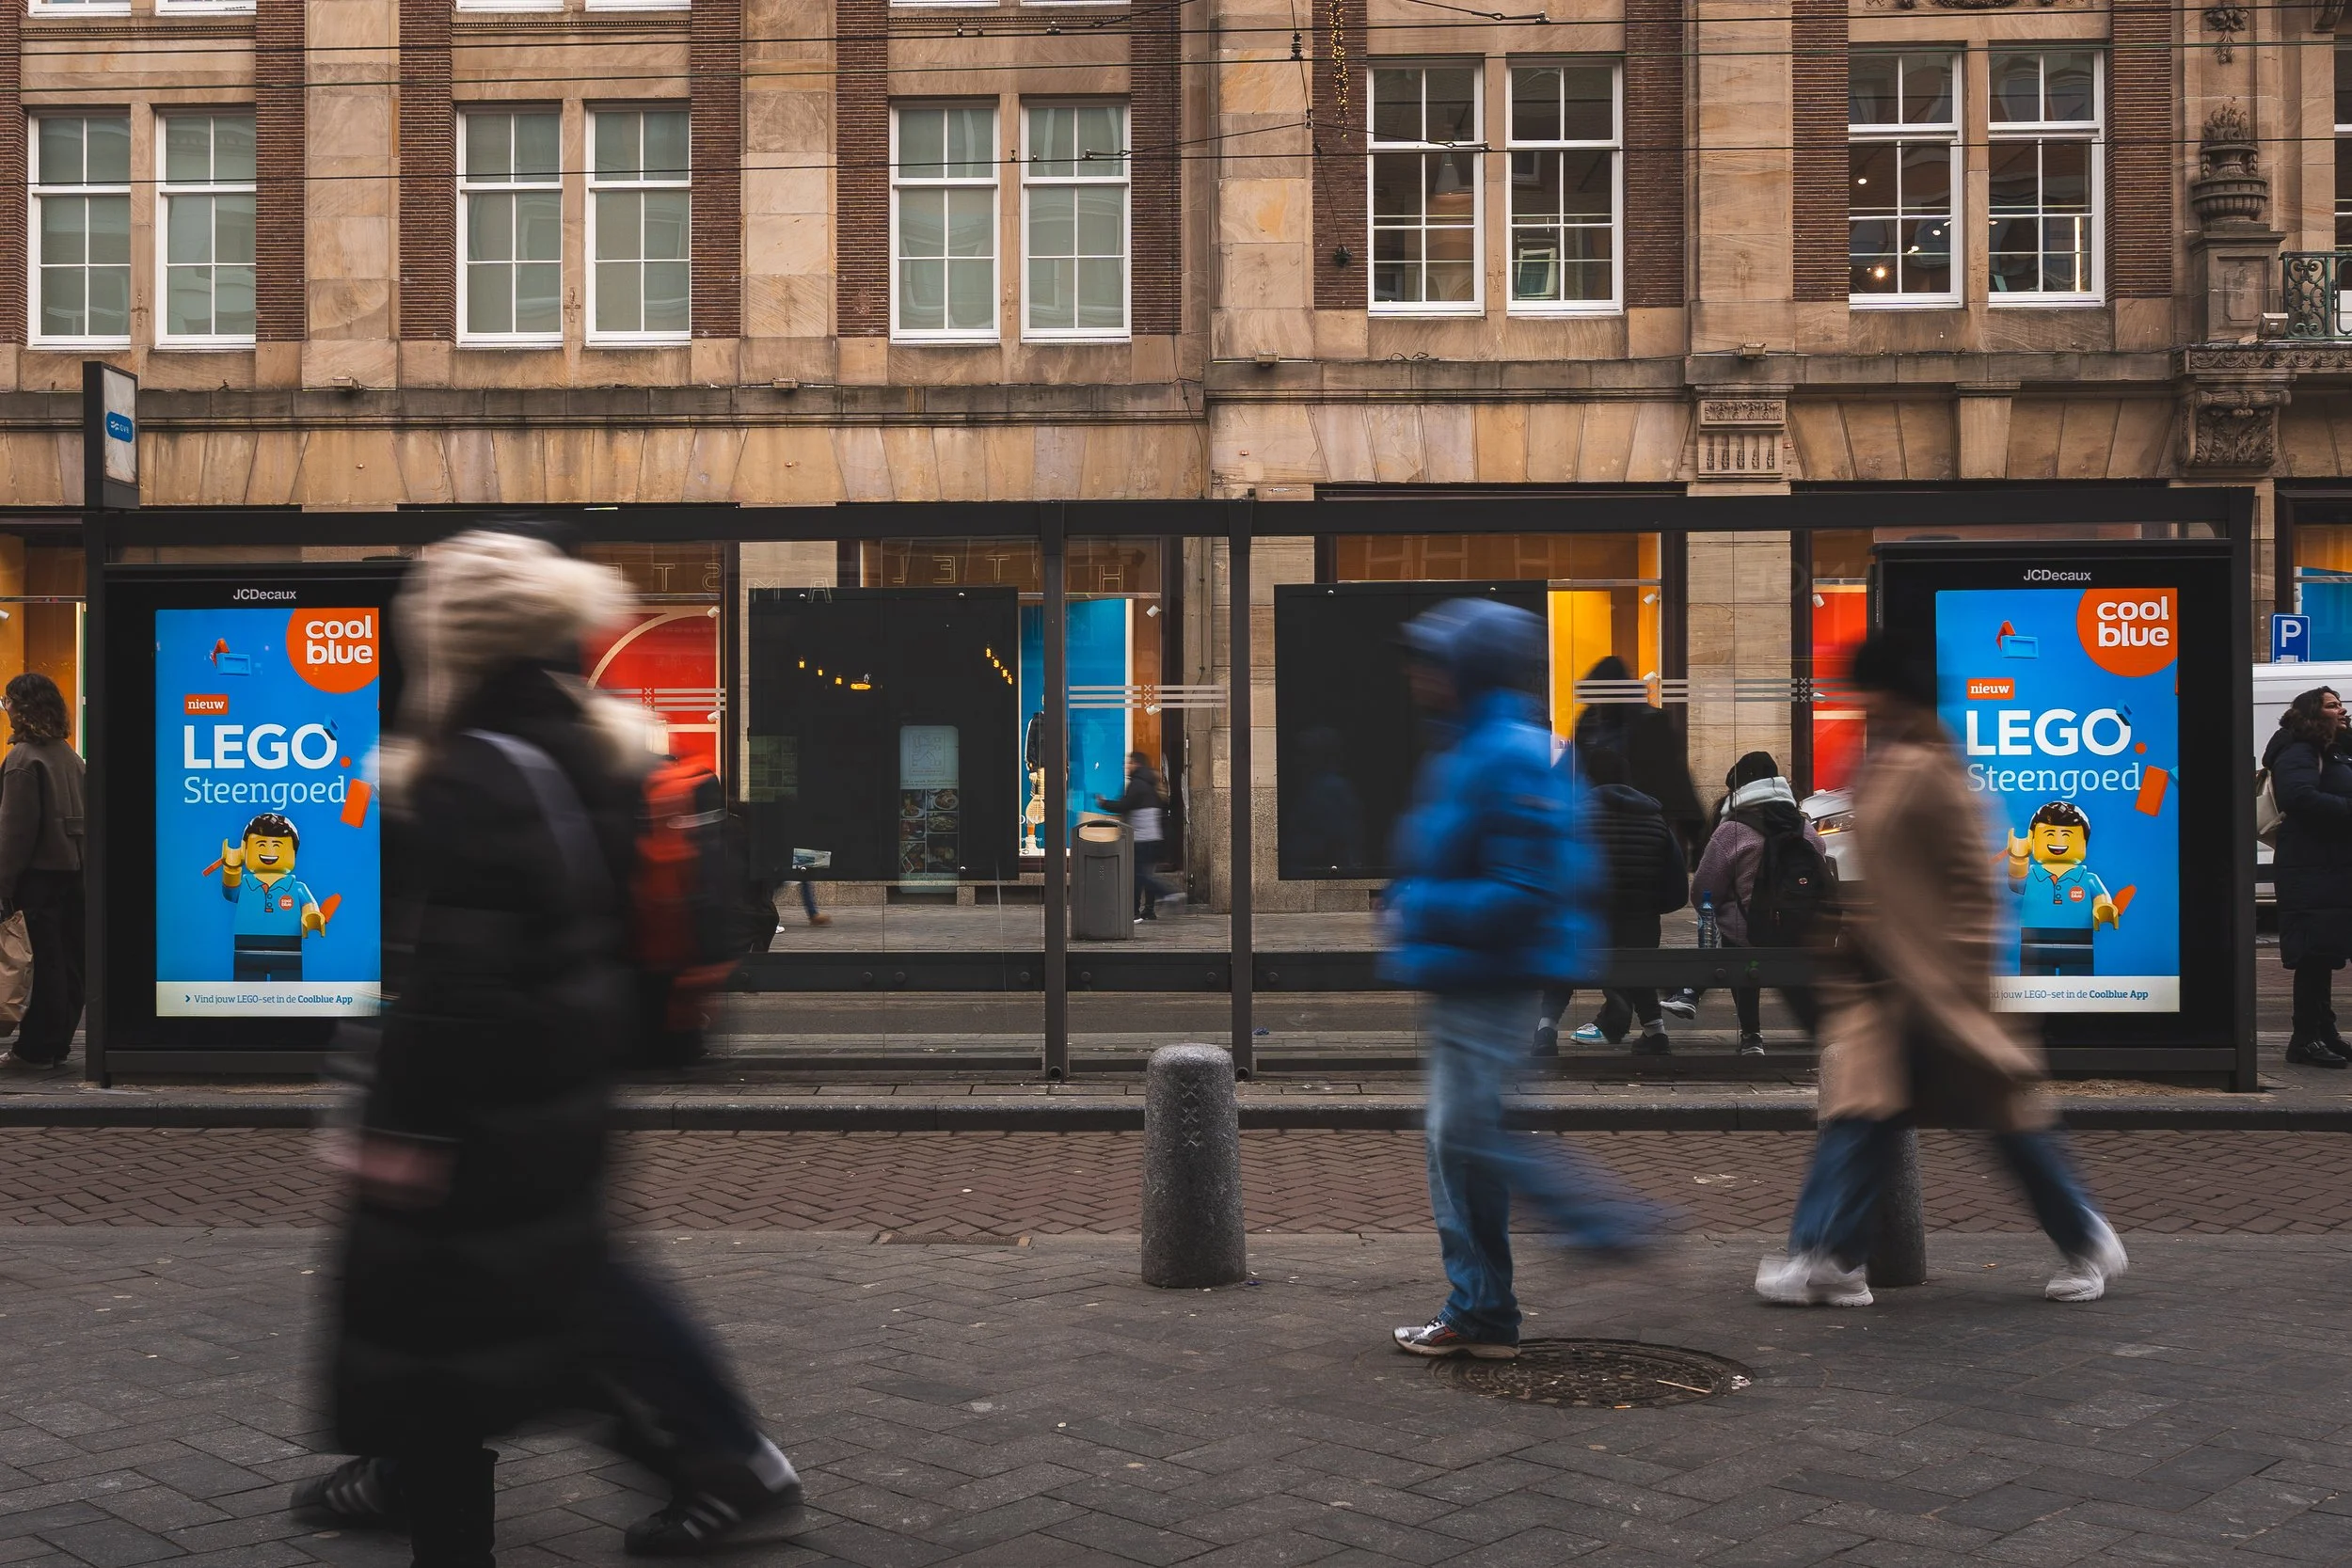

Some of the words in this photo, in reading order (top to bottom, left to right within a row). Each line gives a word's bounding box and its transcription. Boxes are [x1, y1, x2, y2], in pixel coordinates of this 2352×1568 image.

[2023, 569, 2091, 581] JCDecaux
[232, 588, 297, 600] JCDecaux
[2096, 595, 2169, 621] cool
[305, 614, 373, 640] cool
[2097, 621, 2169, 647] blue
[2280, 619, 2302, 648] P
[306, 639, 373, 664] blue
[1970, 683, 2010, 695] nieuw
[187, 698, 225, 710] nieuw
[183, 775, 346, 811] Steengoed
[1966, 762, 2141, 800] Steengoed
[194, 994, 215, 1004] Vind
[215, 994, 235, 1005] jouw
[237, 994, 275, 1004] LEGO-set
[277, 994, 285, 1004] in
[286, 994, 296, 1004] de
[297, 994, 334, 1004] Coolblue
[336, 995, 353, 1006] App
[2000, 990, 2023, 1001] jouw
[2024, 990, 2065, 1000] LEGO-set
[2066, 990, 2075, 1000] in
[2076, 990, 2088, 1000] de
[2089, 990, 2128, 1000] Coolblue
[2130, 990, 2149, 1001] App
